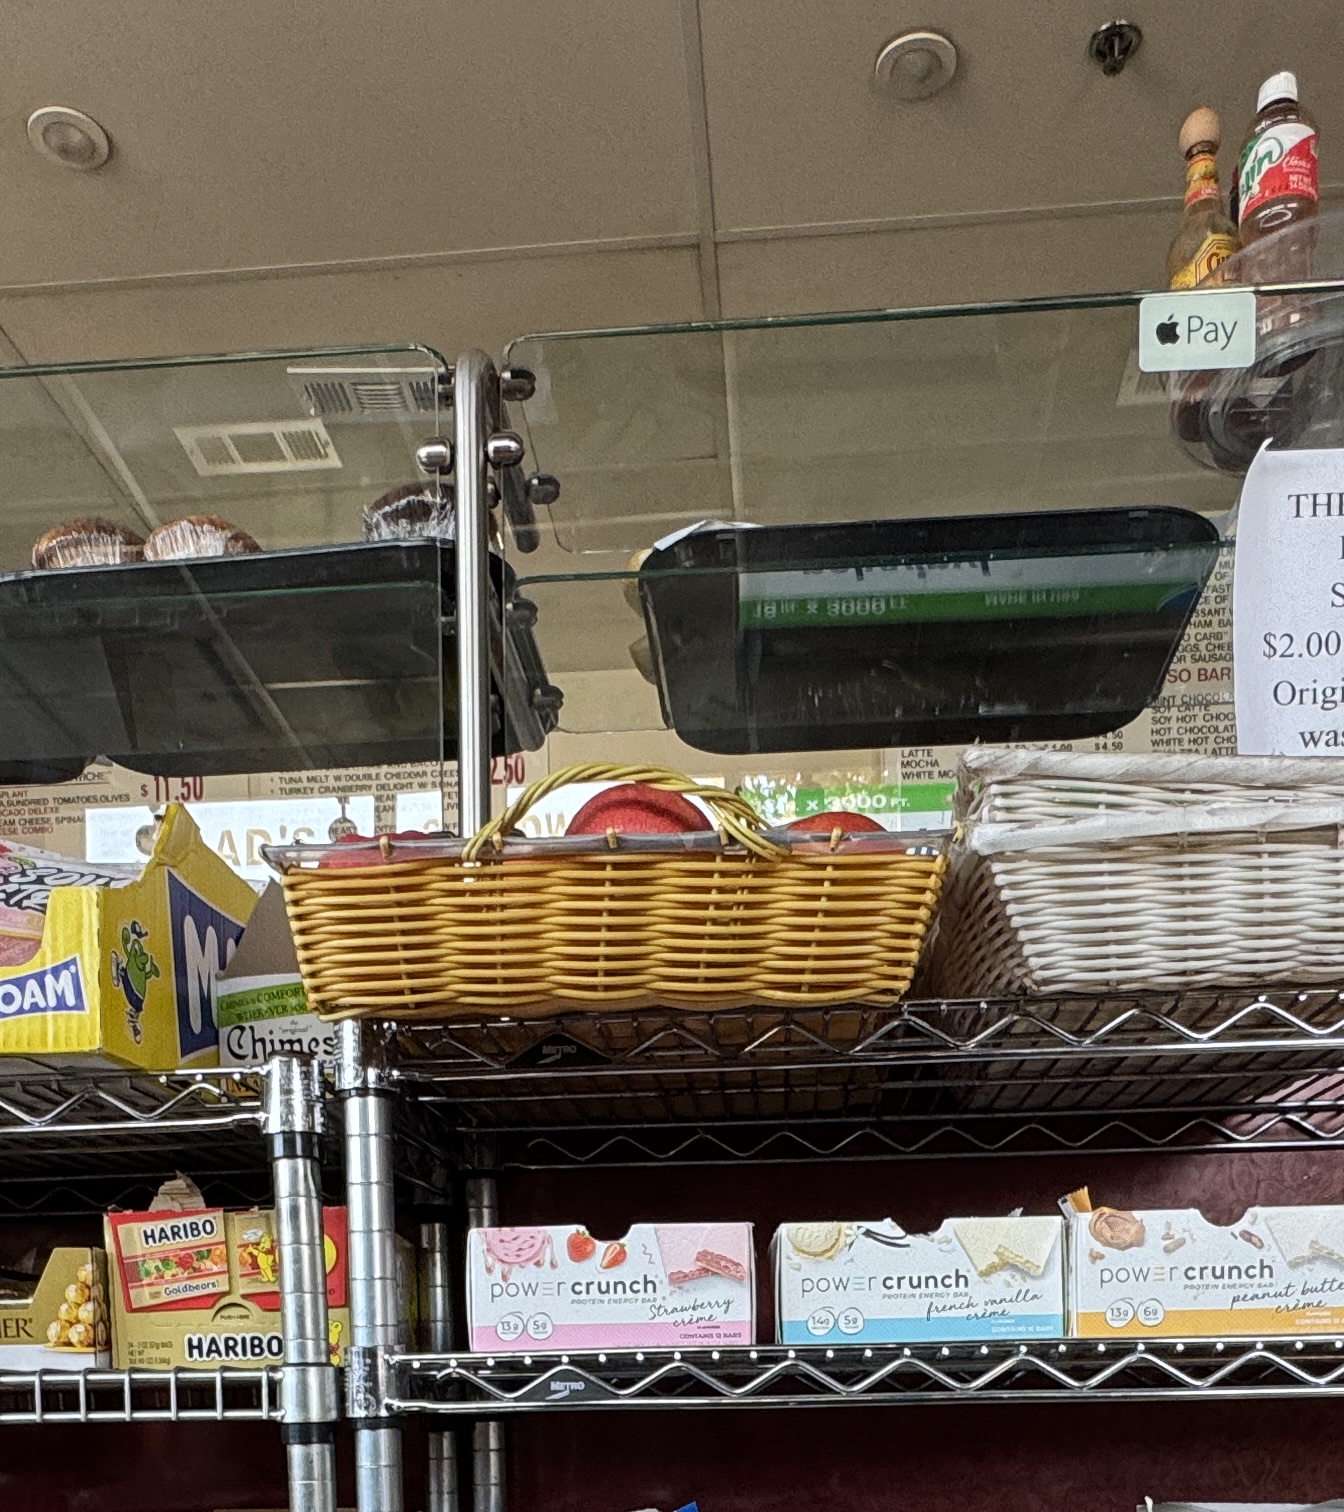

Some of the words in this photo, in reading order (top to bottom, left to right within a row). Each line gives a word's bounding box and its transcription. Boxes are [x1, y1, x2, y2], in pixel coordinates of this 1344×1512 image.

[1187, 316, 1238, 351] Pay
[1263, 630, 1341, 659] $2.00
[1191, 654, 1233, 663] SAUSAG
[1198, 667, 1230, 681] BAR
[1151, 728, 1172, 736] HOT
[1151, 738, 1184, 747] WHITE
[1188, 737, 1209, 746] HOT
[901, 759, 940, 769] MOCHA
[279, 776, 303, 784] TUNA
[384, 770, 427, 779] CHEDDAR
[279, 786, 314, 795] TURKEY
[319, 784, 372, 794] CRANBERRY
[376, 782, 414, 791] DELIGHT
[227, 1025, 335, 1060] Chimes
[144, 1219, 215, 1245] HARIBO
[883, 1269, 969, 1289] crunch
[1184, 1259, 1274, 1280] crunch
[572, 1274, 656, 1295] crunch
[649, 1298, 734, 1320] Strawberry
[927, 1300, 978, 1321] french
[984, 1289, 1043, 1307] vanilla
[188, 1336, 283, 1358] HARIBO
